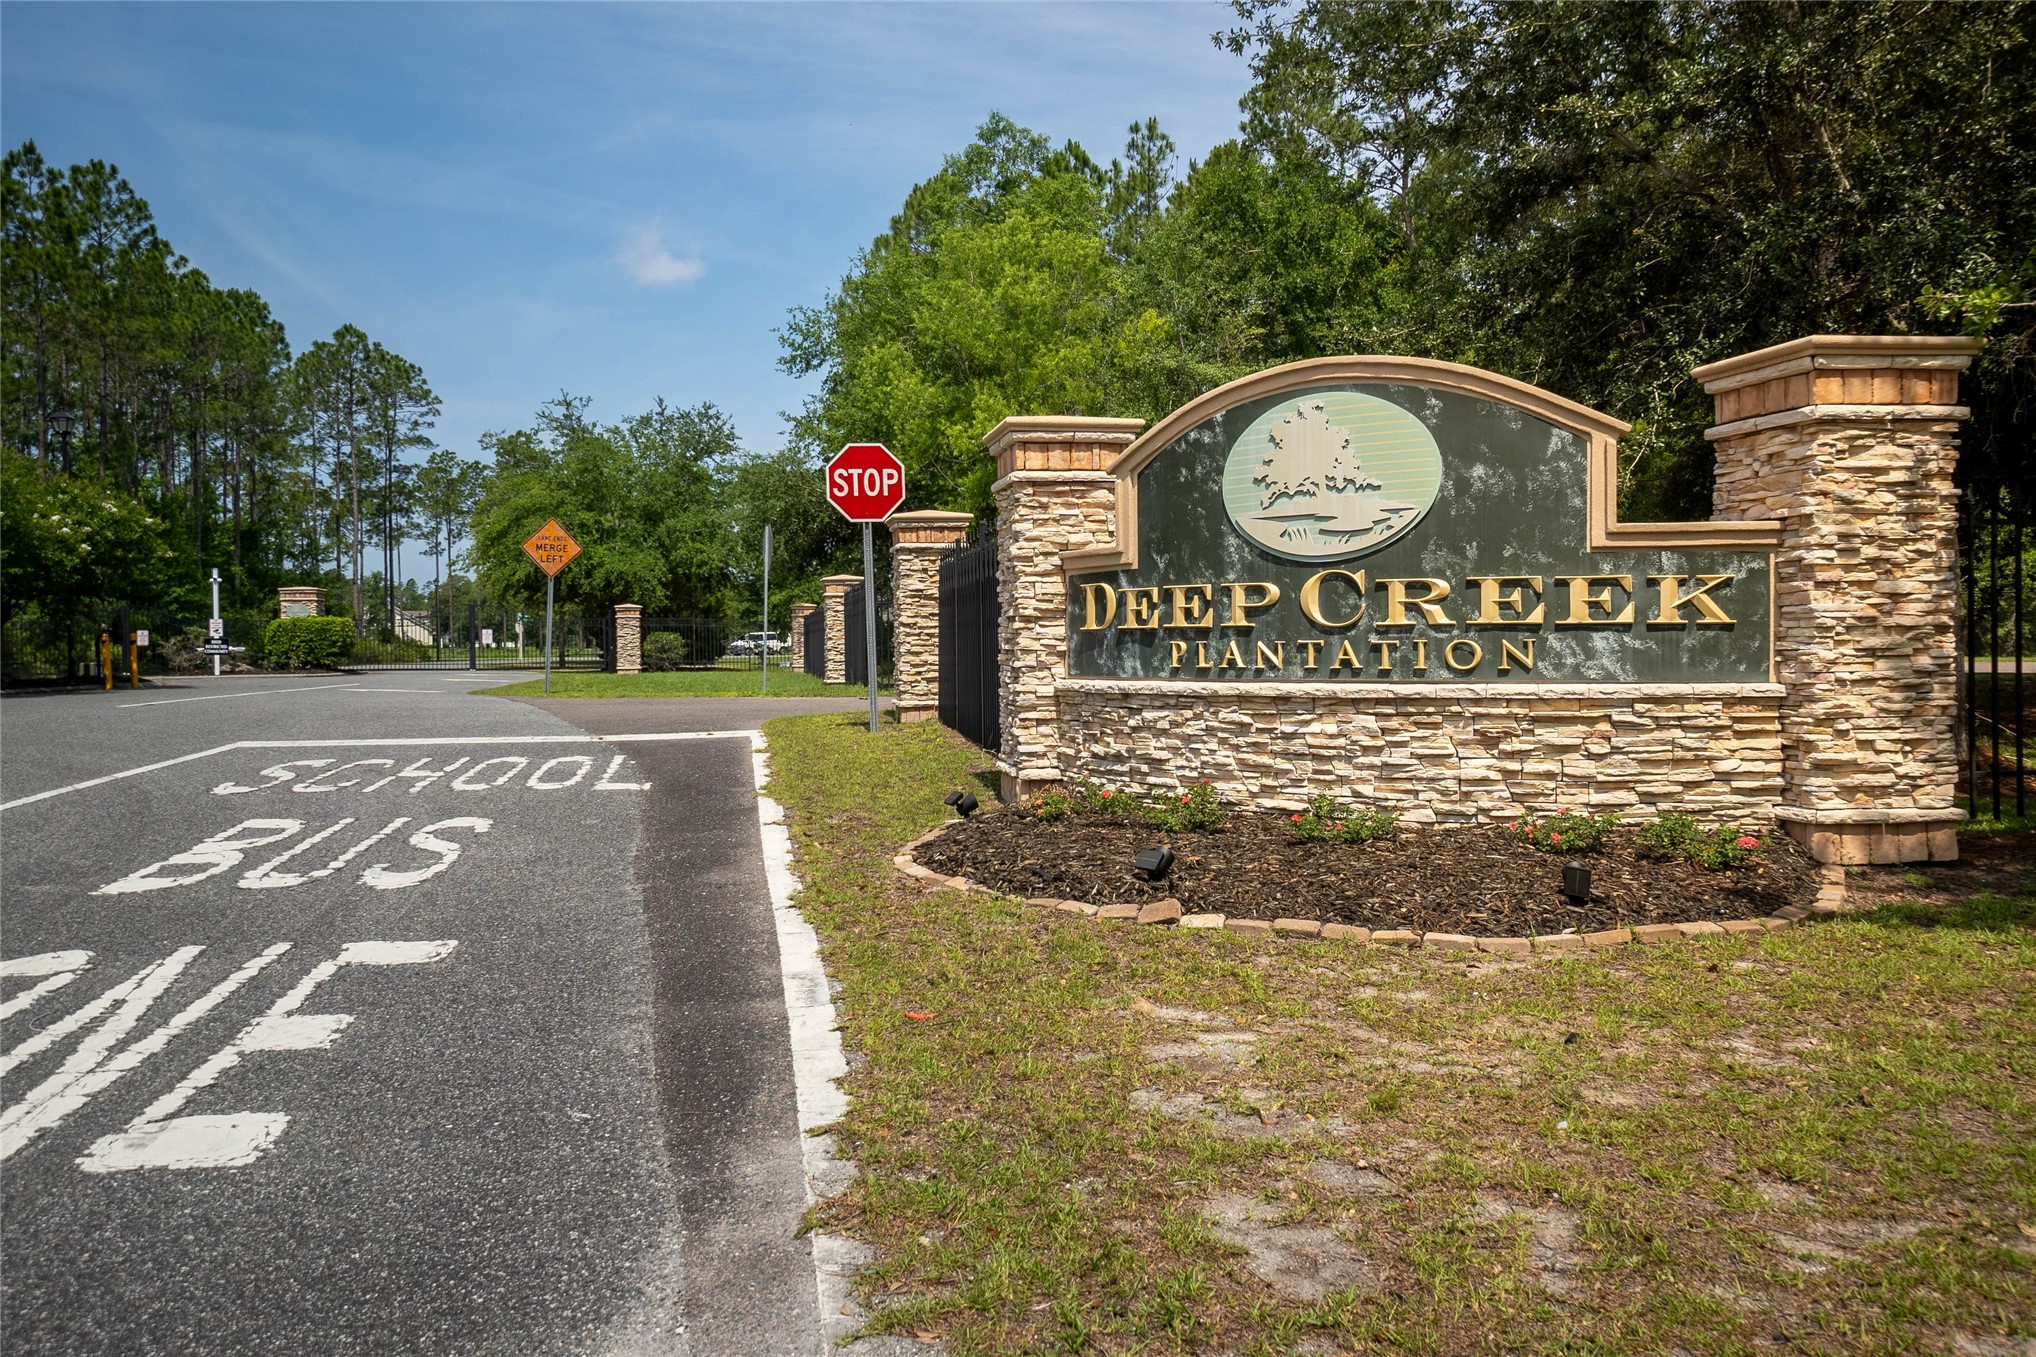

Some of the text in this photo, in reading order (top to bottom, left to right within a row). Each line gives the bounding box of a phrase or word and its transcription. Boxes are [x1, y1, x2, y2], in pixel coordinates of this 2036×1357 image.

[832, 467, 899, 498] STOP
[535, 543, 569, 553] MERGE
[540, 554, 564, 563] LEFT
[1078, 568, 1738, 631] DEEP CREEK
[1169, 637, 1536, 671] PLANTATION
[211, 755, 652, 794] SCHOOL
[88, 817, 494, 895] BUS
